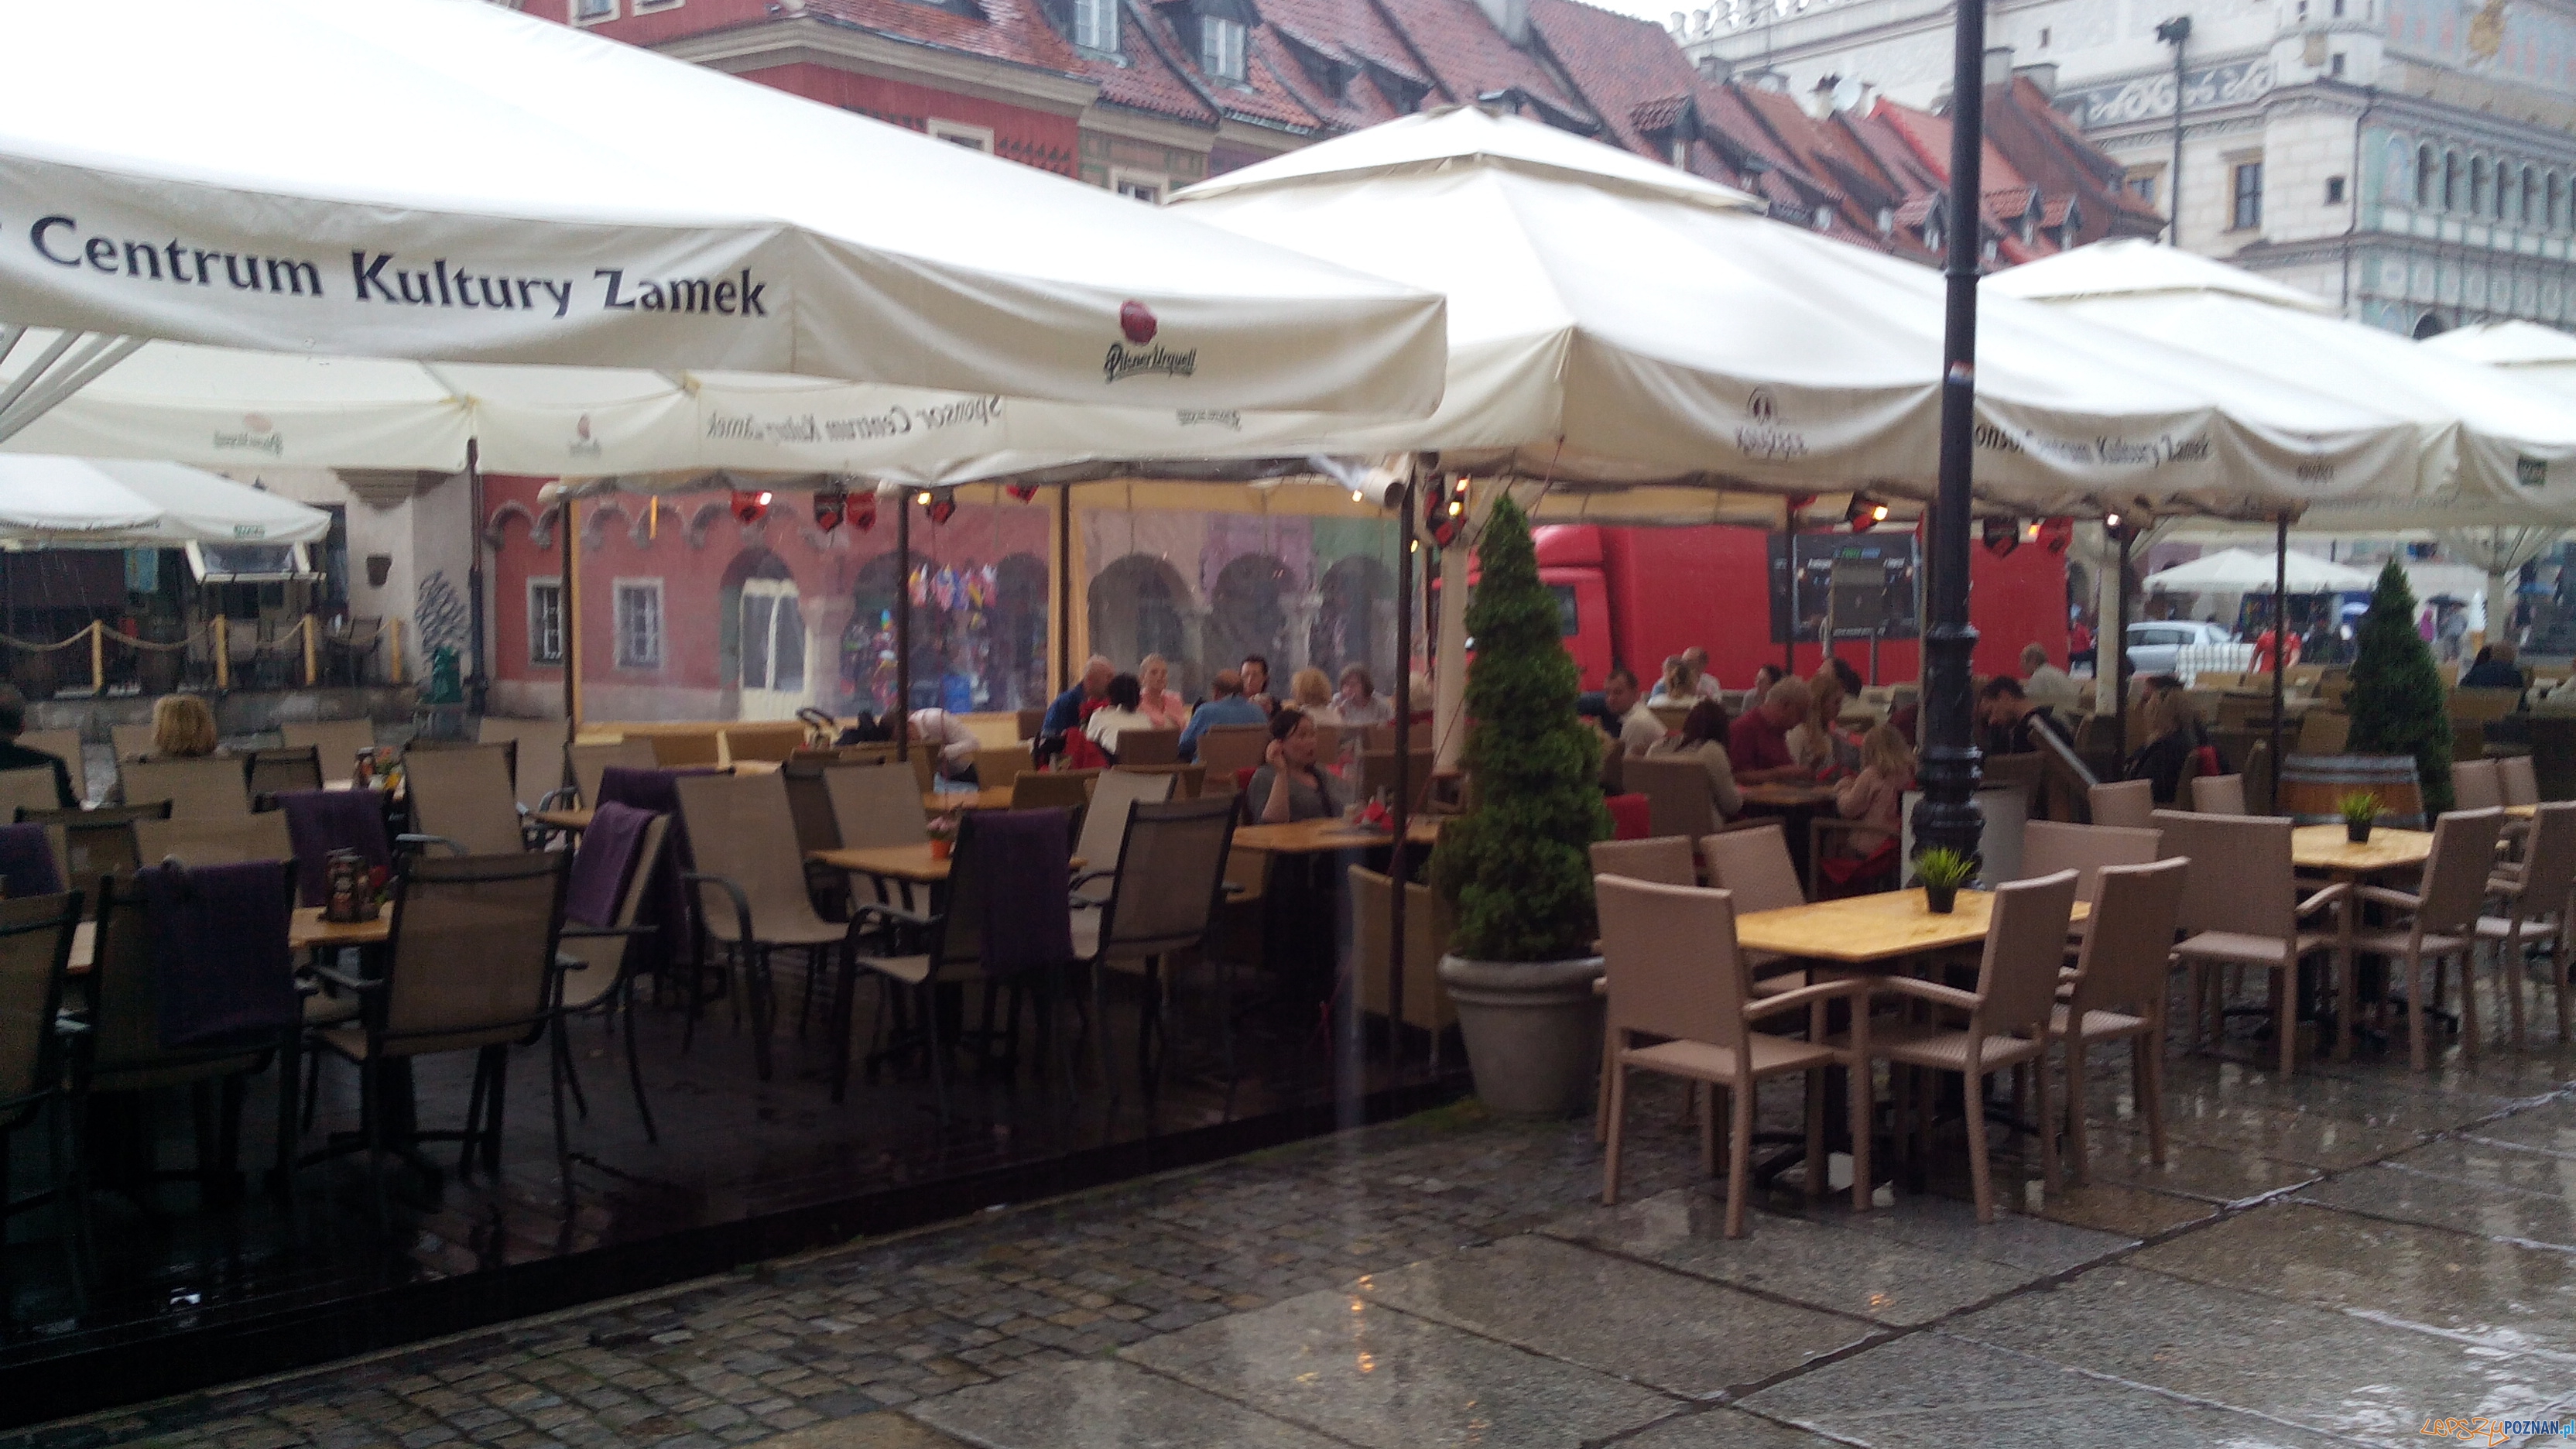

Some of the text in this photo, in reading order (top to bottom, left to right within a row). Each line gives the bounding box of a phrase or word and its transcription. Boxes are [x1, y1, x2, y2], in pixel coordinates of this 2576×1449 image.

[29, 214, 768, 318] Centrum Kultury Zamek
